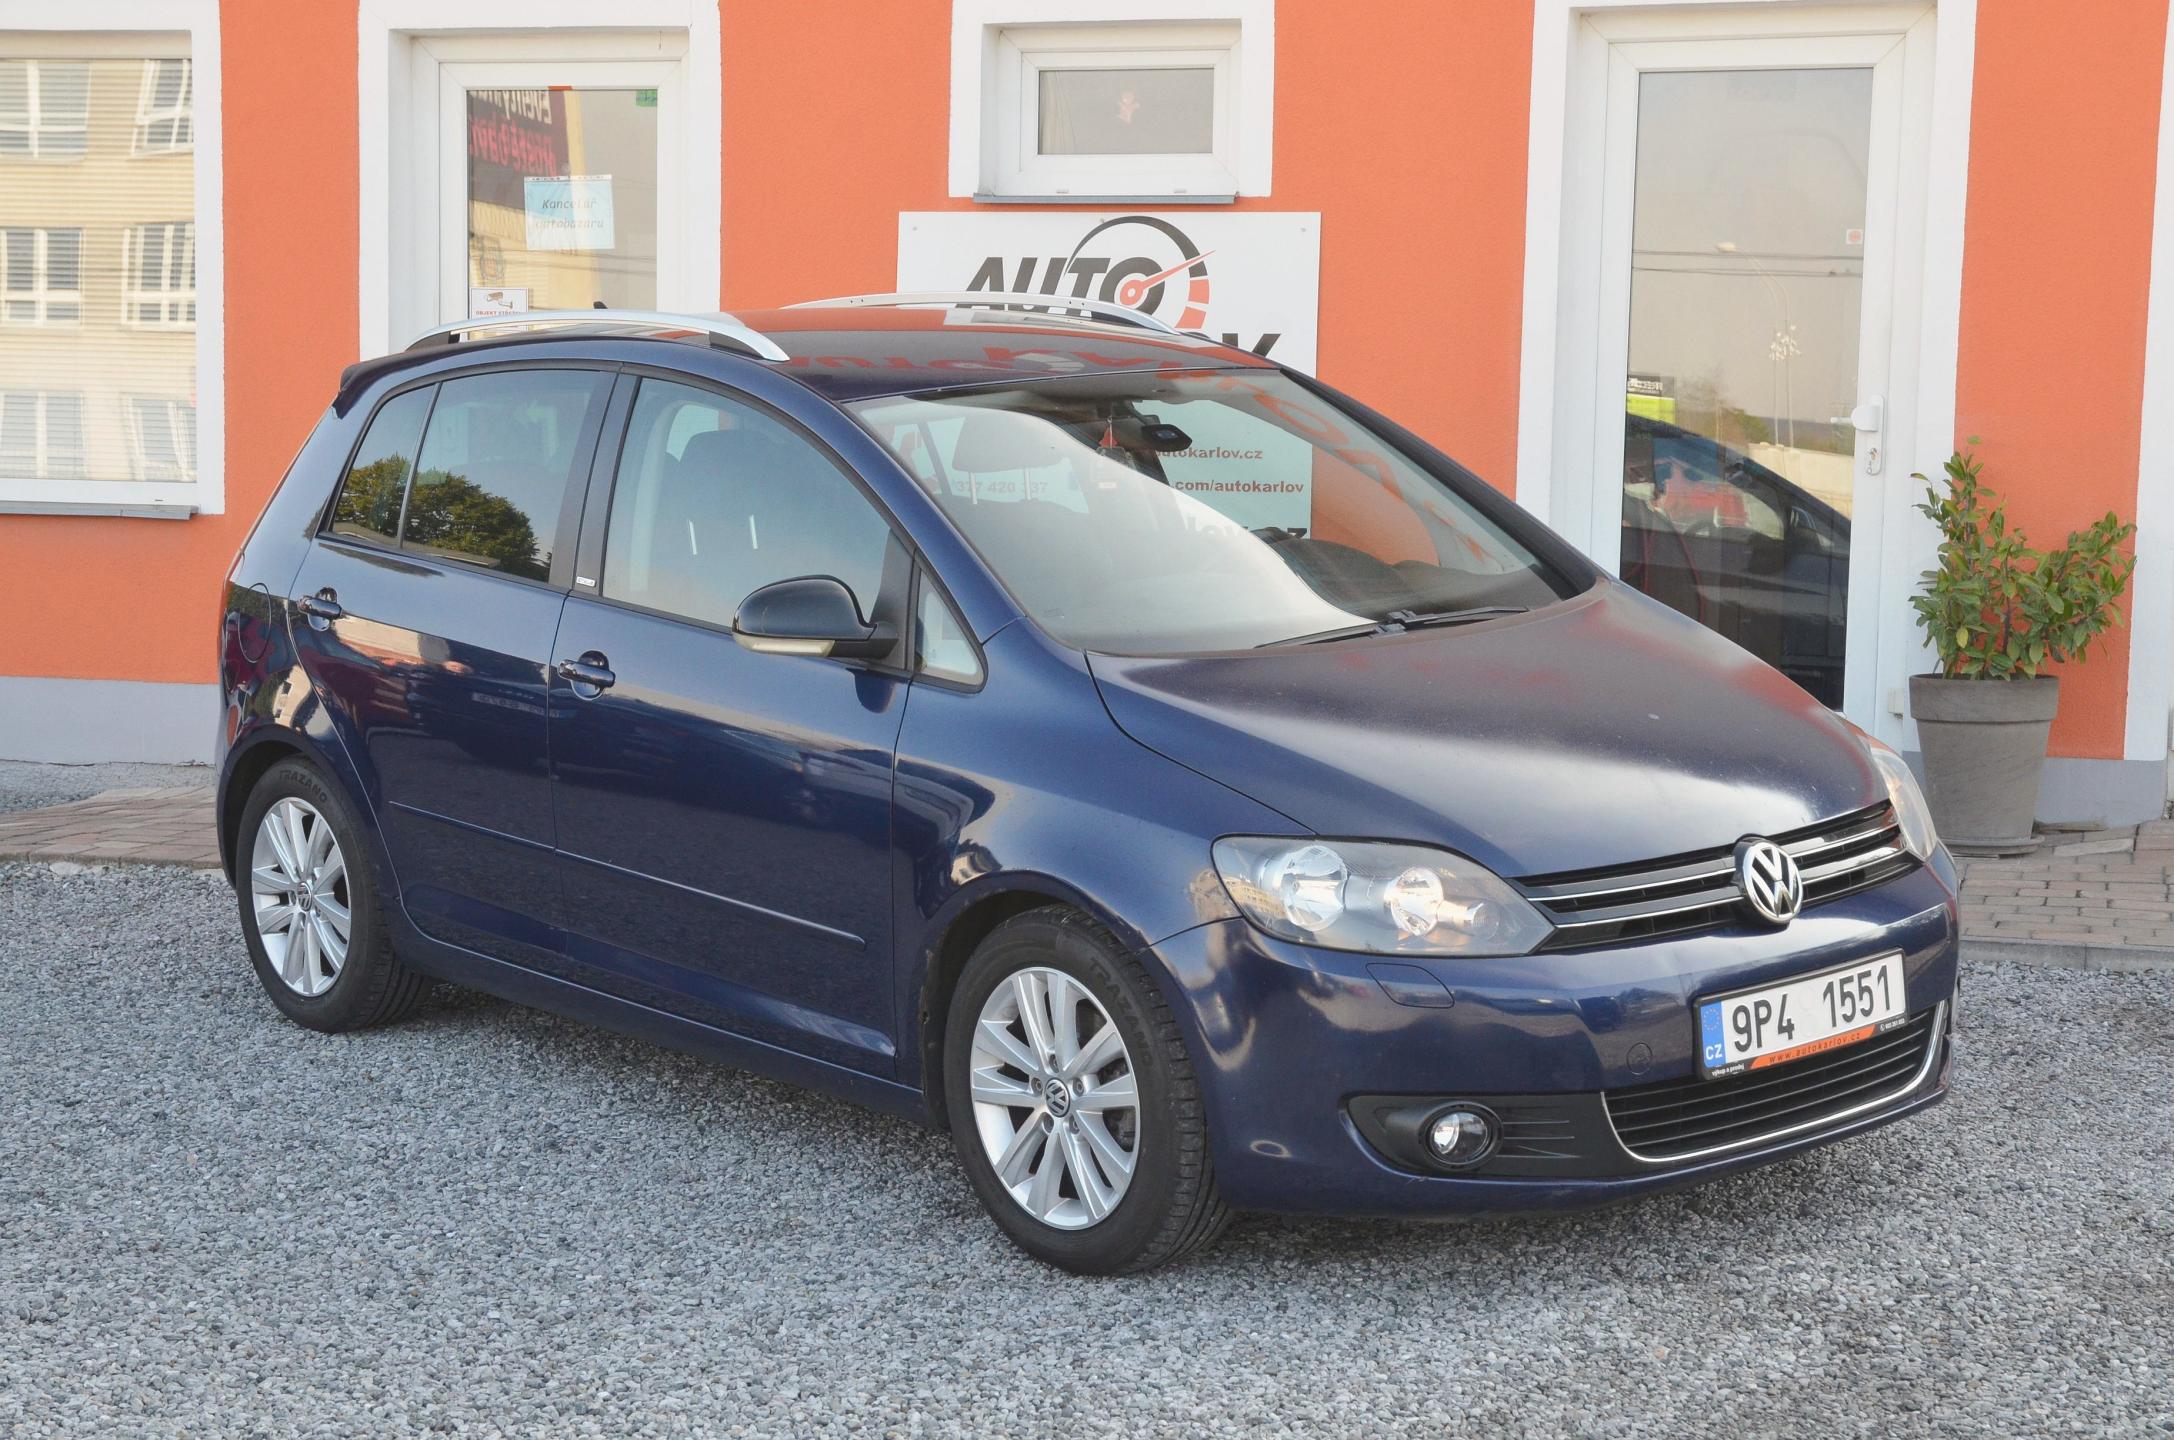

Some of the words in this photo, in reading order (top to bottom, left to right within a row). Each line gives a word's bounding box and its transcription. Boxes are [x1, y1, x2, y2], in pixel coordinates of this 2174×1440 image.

[1732, 993, 1795, 1052] 9P4
[1823, 965, 1890, 1028] 1551
[1705, 1043, 1723, 1060] CZ
[1769, 1032, 1860, 1063] www.autokarlov.cz
